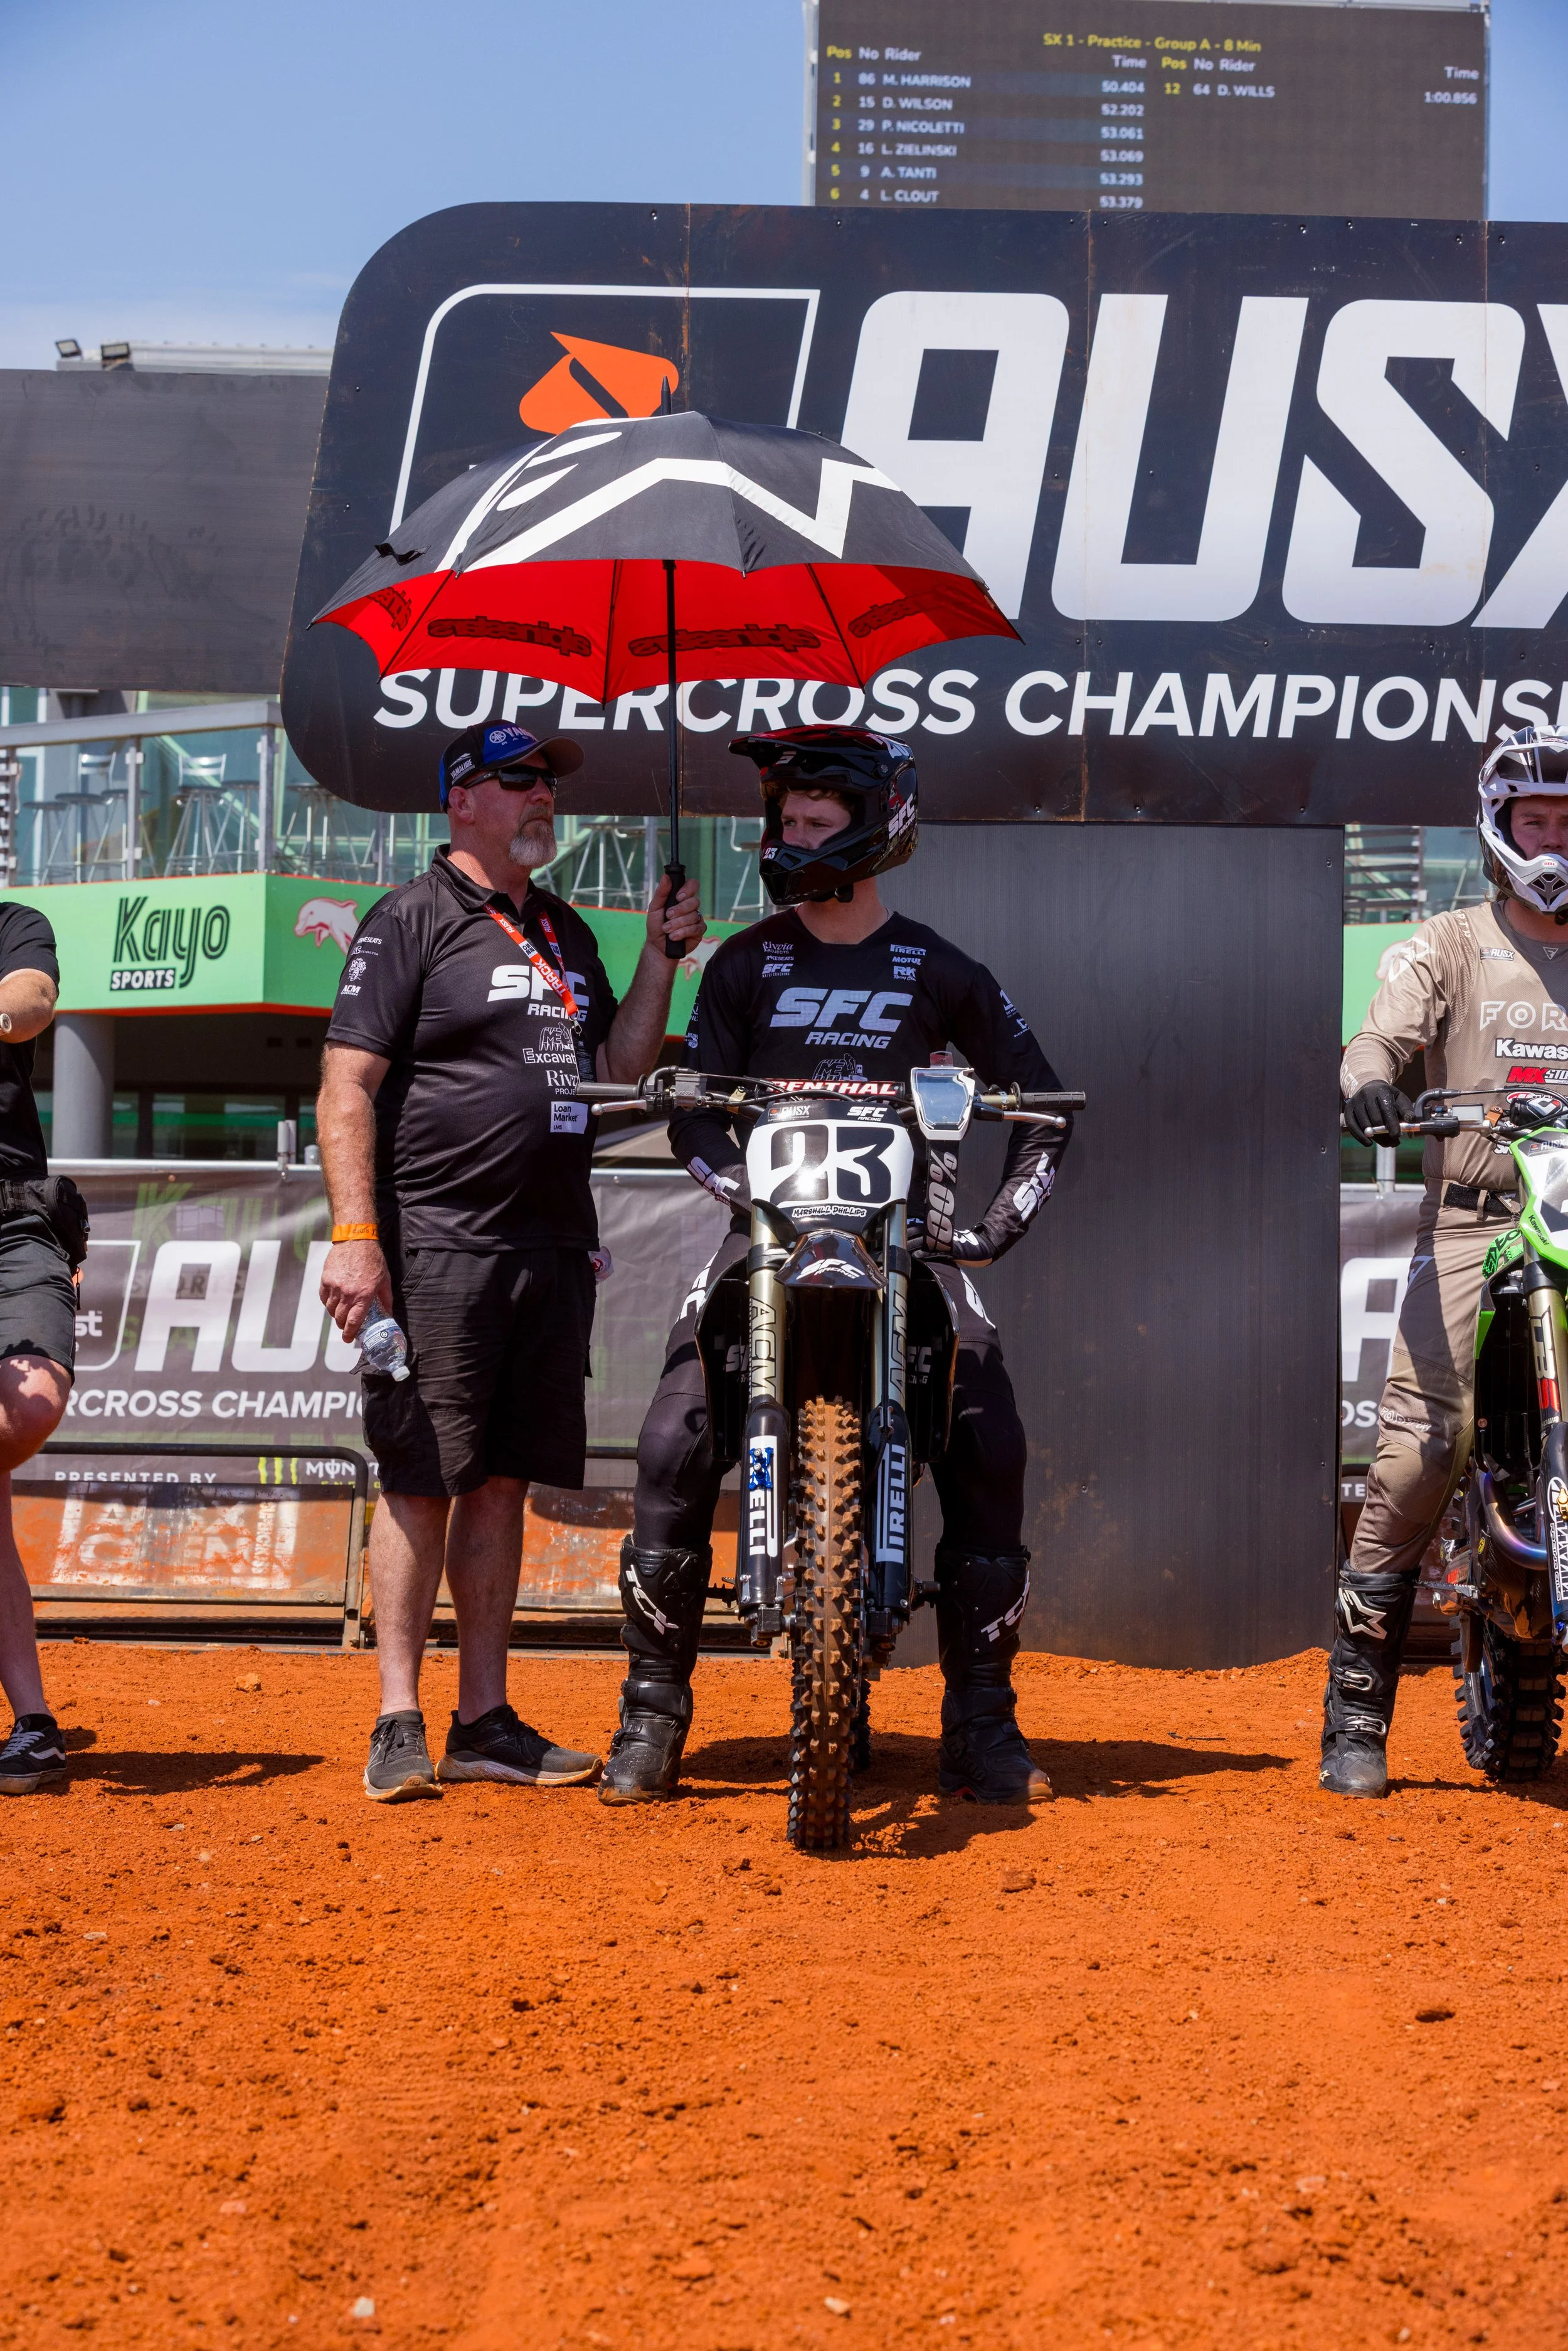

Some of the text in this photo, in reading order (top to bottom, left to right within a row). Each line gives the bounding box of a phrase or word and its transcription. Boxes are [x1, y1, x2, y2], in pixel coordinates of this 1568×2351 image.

[1043, 33, 1062, 46] SX
[1067, 34, 1074, 46] 1
[1088, 34, 1142, 48] Practice
[1154, 36, 1197, 52] Group
[1200, 38, 1211, 51] A
[1224, 40, 1233, 51] 8
[1236, 40, 1262, 52] Min
[827, 45, 1147, 69] Pos No Rider Time
[1161, 56, 1480, 80] Pos No Rider Time
[834, 72, 841, 83] 1
[858, 73, 876, 85] 86
[901, 75, 971, 88] HARRISON
[1101, 80, 1145, 93] 50.404
[1164, 82, 1181, 95] 12
[1193, 83, 1210, 95] 64
[1233, 85, 1275, 98] WILLS
[832, 95, 841, 107] 2
[859, 96, 876, 109] 15
[898, 98, 953, 110] WILSON
[1101, 103, 1145, 117] 52.202
[832, 118, 841, 130] 3
[858, 119, 875, 131] 29
[896, 120, 965, 134] NICOLETTI
[1100, 127, 1144, 140] 53.061
[831, 141, 840, 153] 4
[858, 142, 874, 154] 16
[895, 144, 957, 157] ZIELINSKI
[1100, 149, 1144, 163] 53.069
[831, 164, 840, 176] 5
[860, 165, 870, 178] 9
[898, 166, 937, 179] TANTI
[1099, 172, 1143, 186] 53.293
[830, 187, 839, 199] 6
[860, 189, 869, 201] 4
[894, 189, 940, 203] CLOUT
[1099, 196, 1143, 209] 53.379
[373, 667, 980, 736] SUPERCROSS
[450, 758, 473, 780] YAMALUBE
[888, 793, 916, 840] SFC
[763, 847, 778, 859] 23
[112, 896, 231, 989] Kayo
[890, 943, 926, 956] PIRELLI
[762, 963, 794, 974] SFC
[892, 956, 921, 965] MOTUL
[893, 965, 916, 978] RK
[110, 969, 175, 990] SPORTS
[535, 958, 566, 997] TRACK
[769, 987, 913, 1032] SFC
[1480, 1000, 1568, 1032] FOR
[804, 1031, 892, 1049] RACING
[1495, 1039, 1568, 1060] Kawas
[765, 1080, 897, 1096] RENTHAL
[553, 1113, 578, 1122] Market
[554, 1104, 571, 1113] Loan
[847, 1106, 888, 1118] SFC
[770, 1124, 894, 1207] 23
[793, 1205, 867, 1218] MARSHALL PHILLIPS
[1528, 1214, 1550, 1246] Kawasaki
[796, 1258, 866, 1280] SFC
[814, 1266, 858, 1279] RACING
[65, 1389, 363, 1418] RCROSS CHAMPI
[876, 1443, 906, 1564] PIRELLI
[489, 1734, 509, 1746] balance
